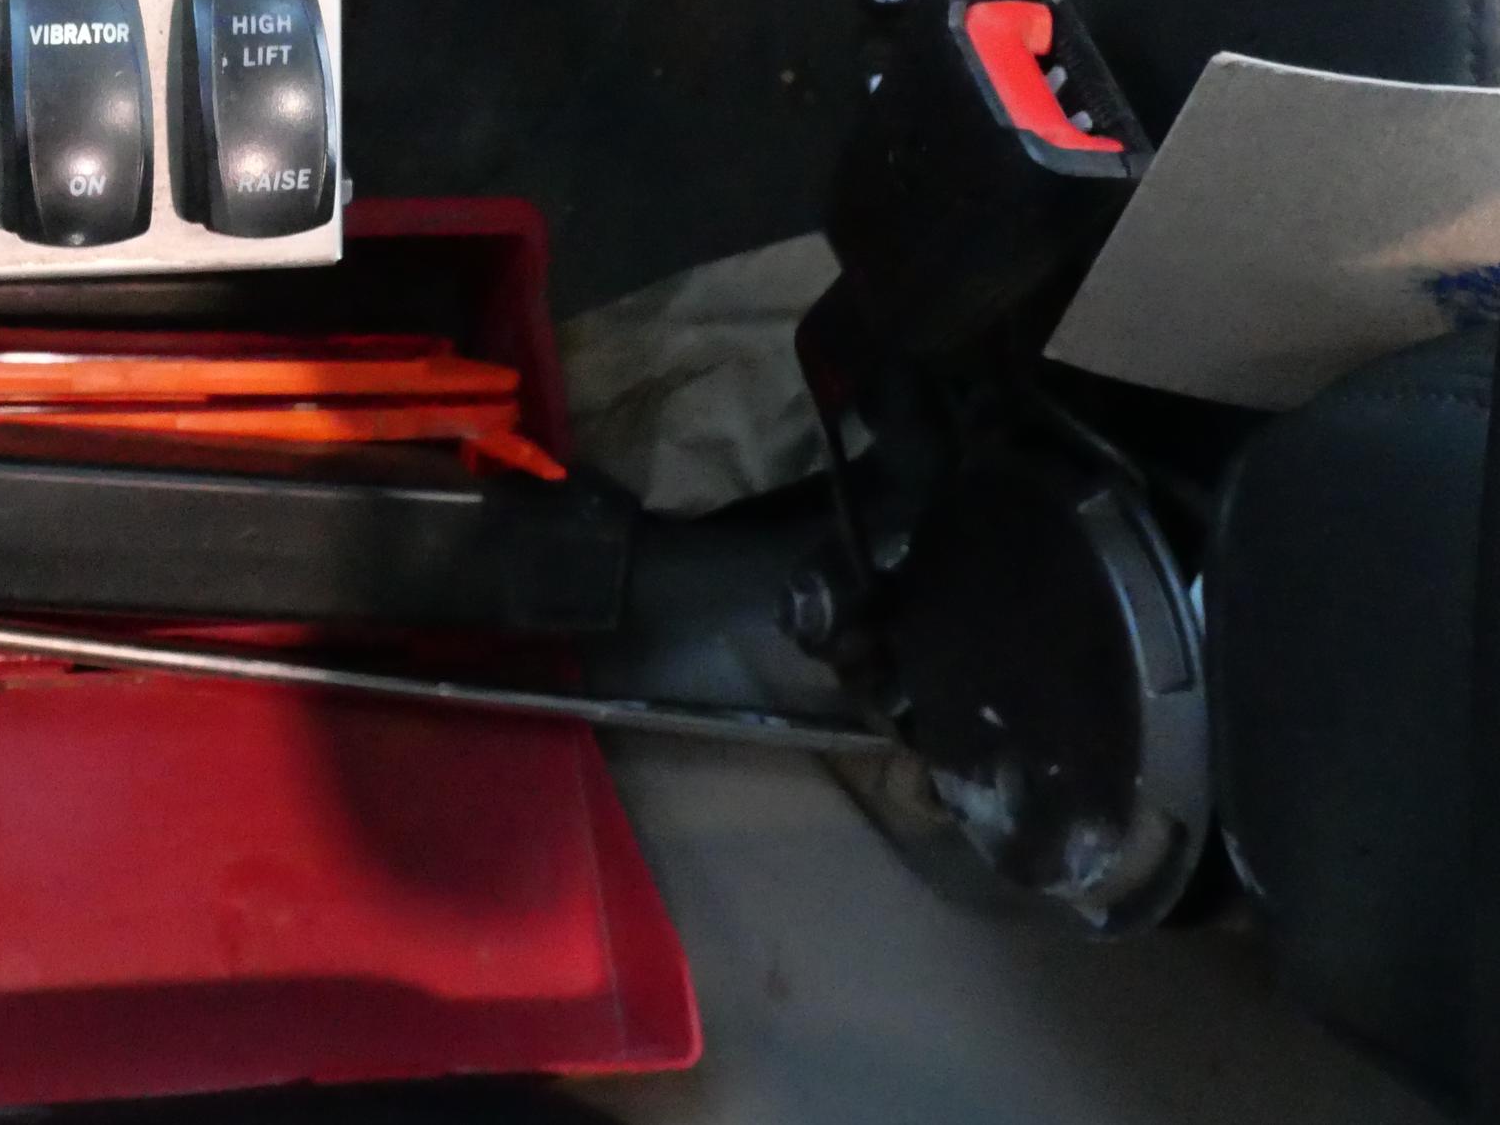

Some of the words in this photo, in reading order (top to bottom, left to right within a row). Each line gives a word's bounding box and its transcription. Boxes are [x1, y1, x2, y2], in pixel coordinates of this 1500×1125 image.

[29, 23, 129, 46] VIBRATOR
[231, 14, 292, 35] HIGH
[243, 45, 293, 68] LIFT
[68, 175, 106, 197] ON
[237, 168, 312, 193] RAISE
